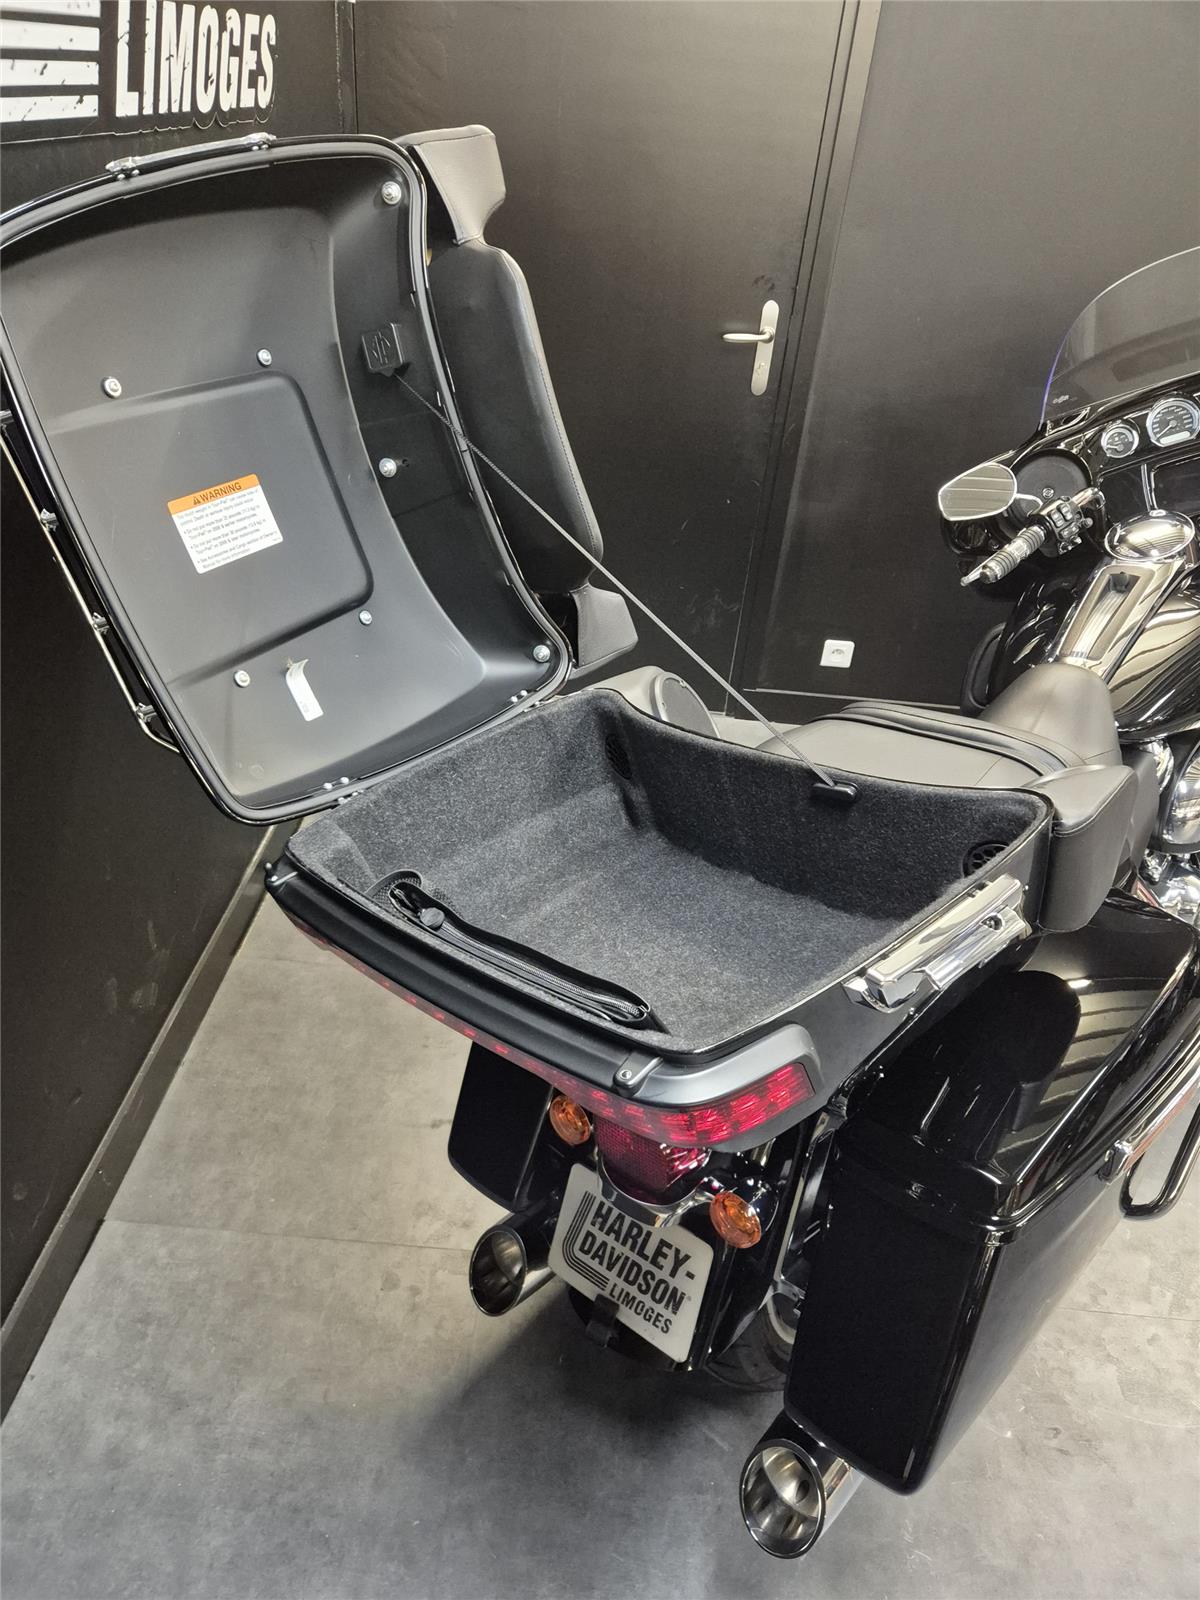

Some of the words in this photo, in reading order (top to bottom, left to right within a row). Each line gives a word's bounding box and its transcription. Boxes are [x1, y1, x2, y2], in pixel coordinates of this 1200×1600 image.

[115, 0, 276, 117] LIMOGES
[200, 482, 242, 503] WARNING
[578, 1230, 686, 1315] DAVIDSON
[591, 1201, 696, 1281] HARLEY-
[608, 1283, 673, 1334] LIMOGES
